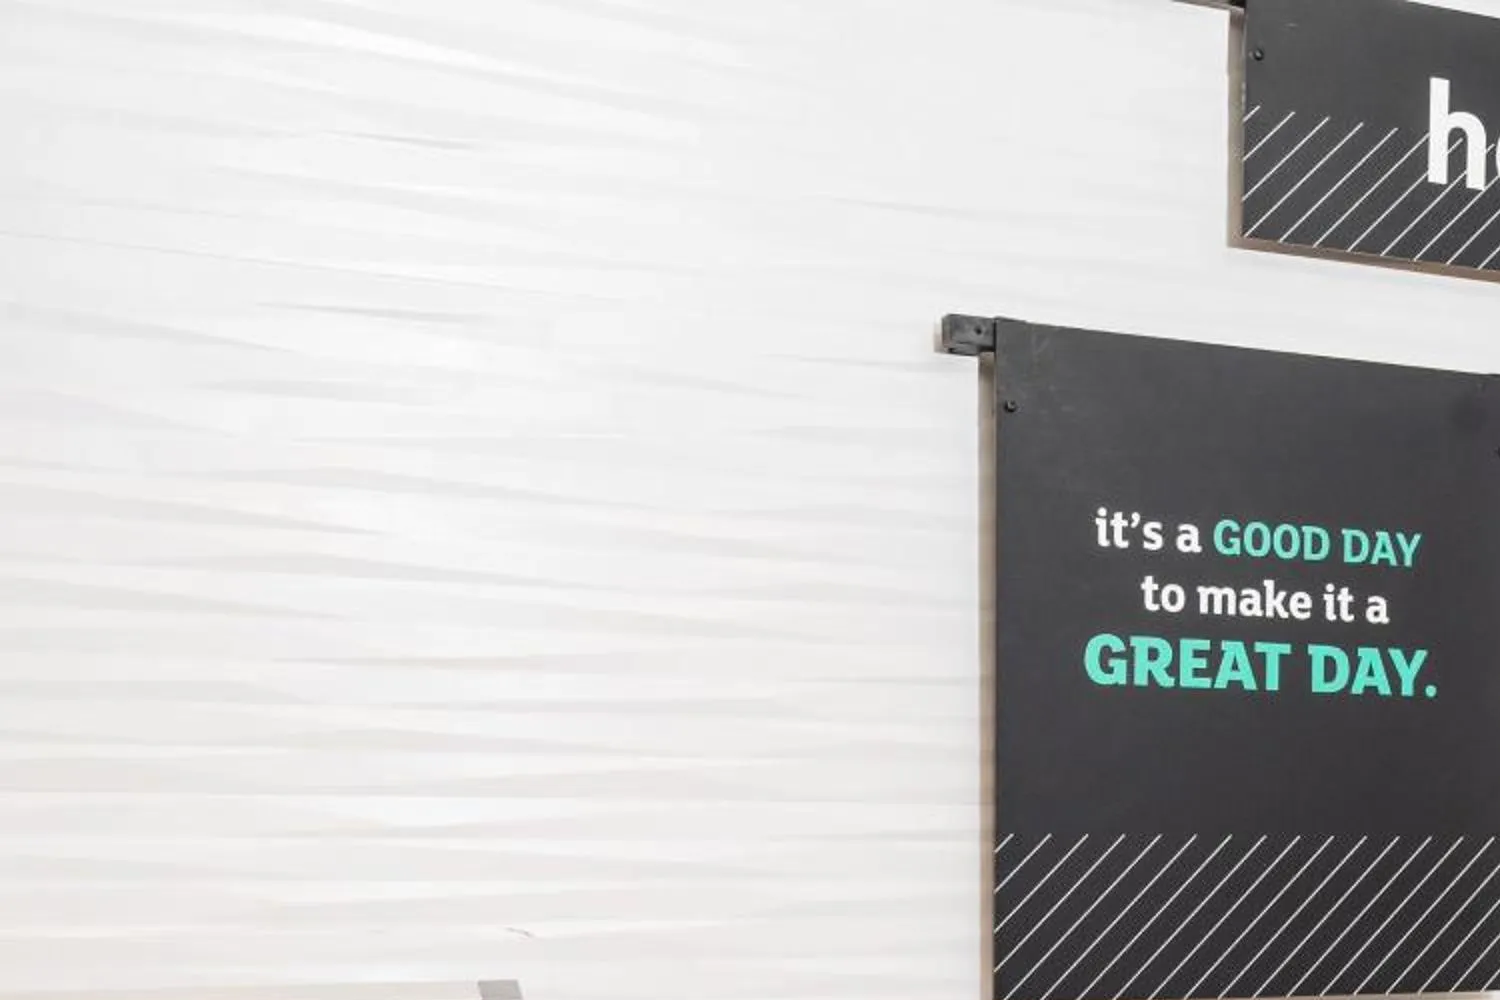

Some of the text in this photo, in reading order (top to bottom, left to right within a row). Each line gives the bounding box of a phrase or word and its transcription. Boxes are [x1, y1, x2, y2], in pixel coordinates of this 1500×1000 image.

[1095, 506, 1422, 567] it’s a GOOD DAY
[1141, 575, 1390, 625] to make it a
[1083, 632, 1438, 698] GREAT DAY.
